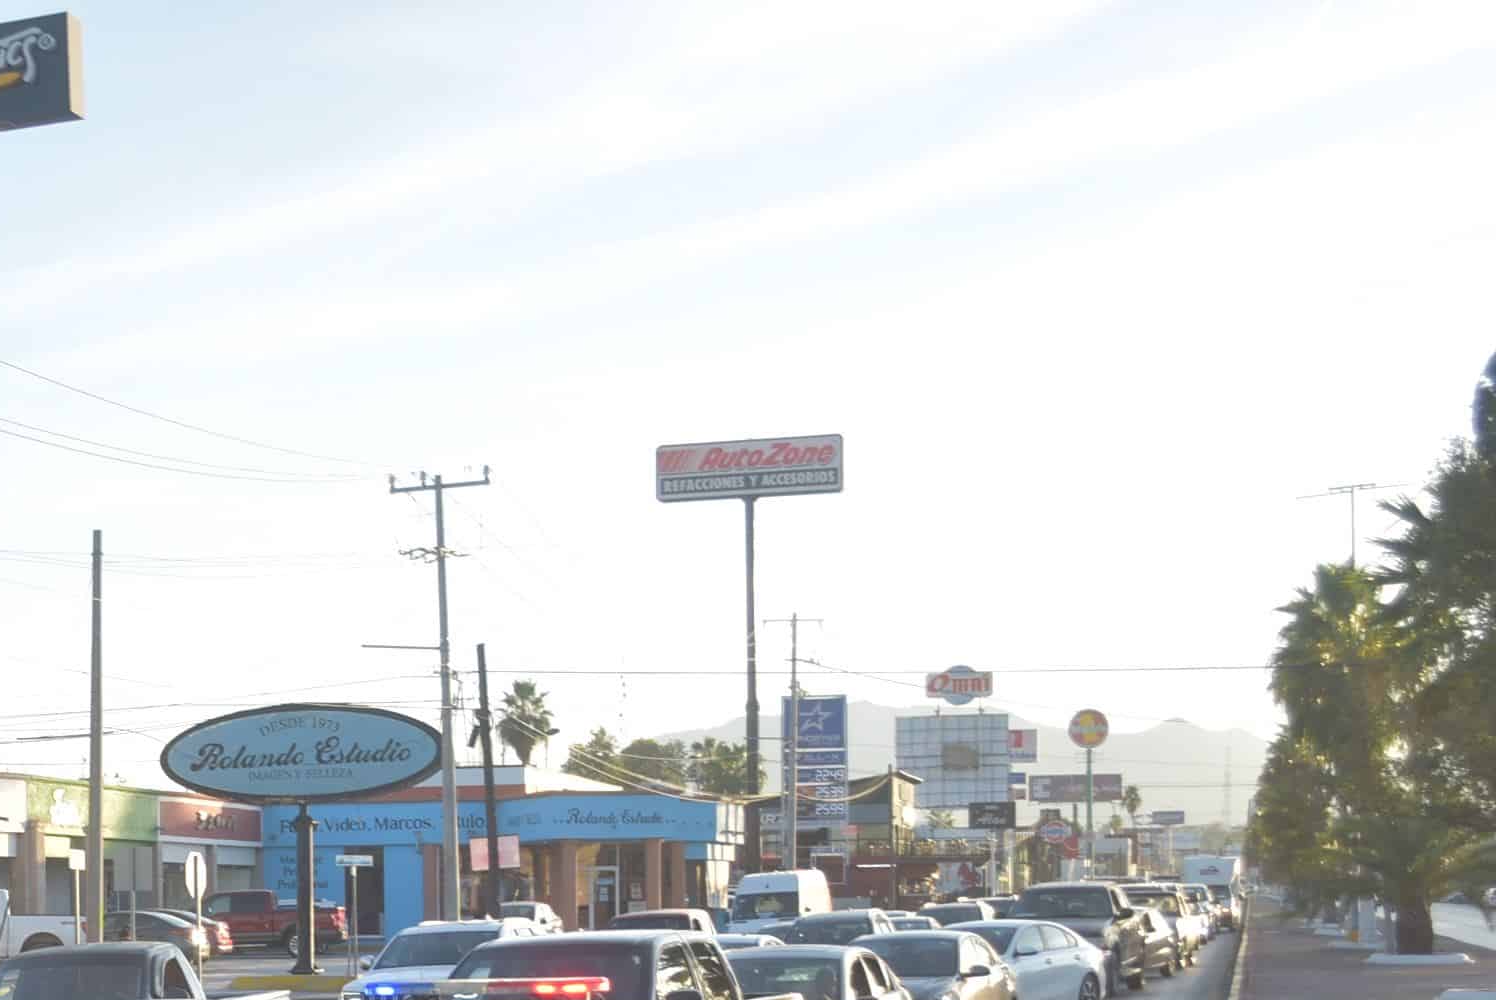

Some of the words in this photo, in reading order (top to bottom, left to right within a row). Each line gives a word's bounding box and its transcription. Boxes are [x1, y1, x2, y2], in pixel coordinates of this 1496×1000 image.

[699, 443, 836, 471] AutoZone
[663, 475, 745, 494] REFACCIONES
[750, 474, 760, 486] Y
[761, 469, 836, 487] ACCESORIOS
[259, 717, 305, 737] DESDE
[190, 742, 305, 772] Rolando
[314, 736, 411, 766] Estudio
